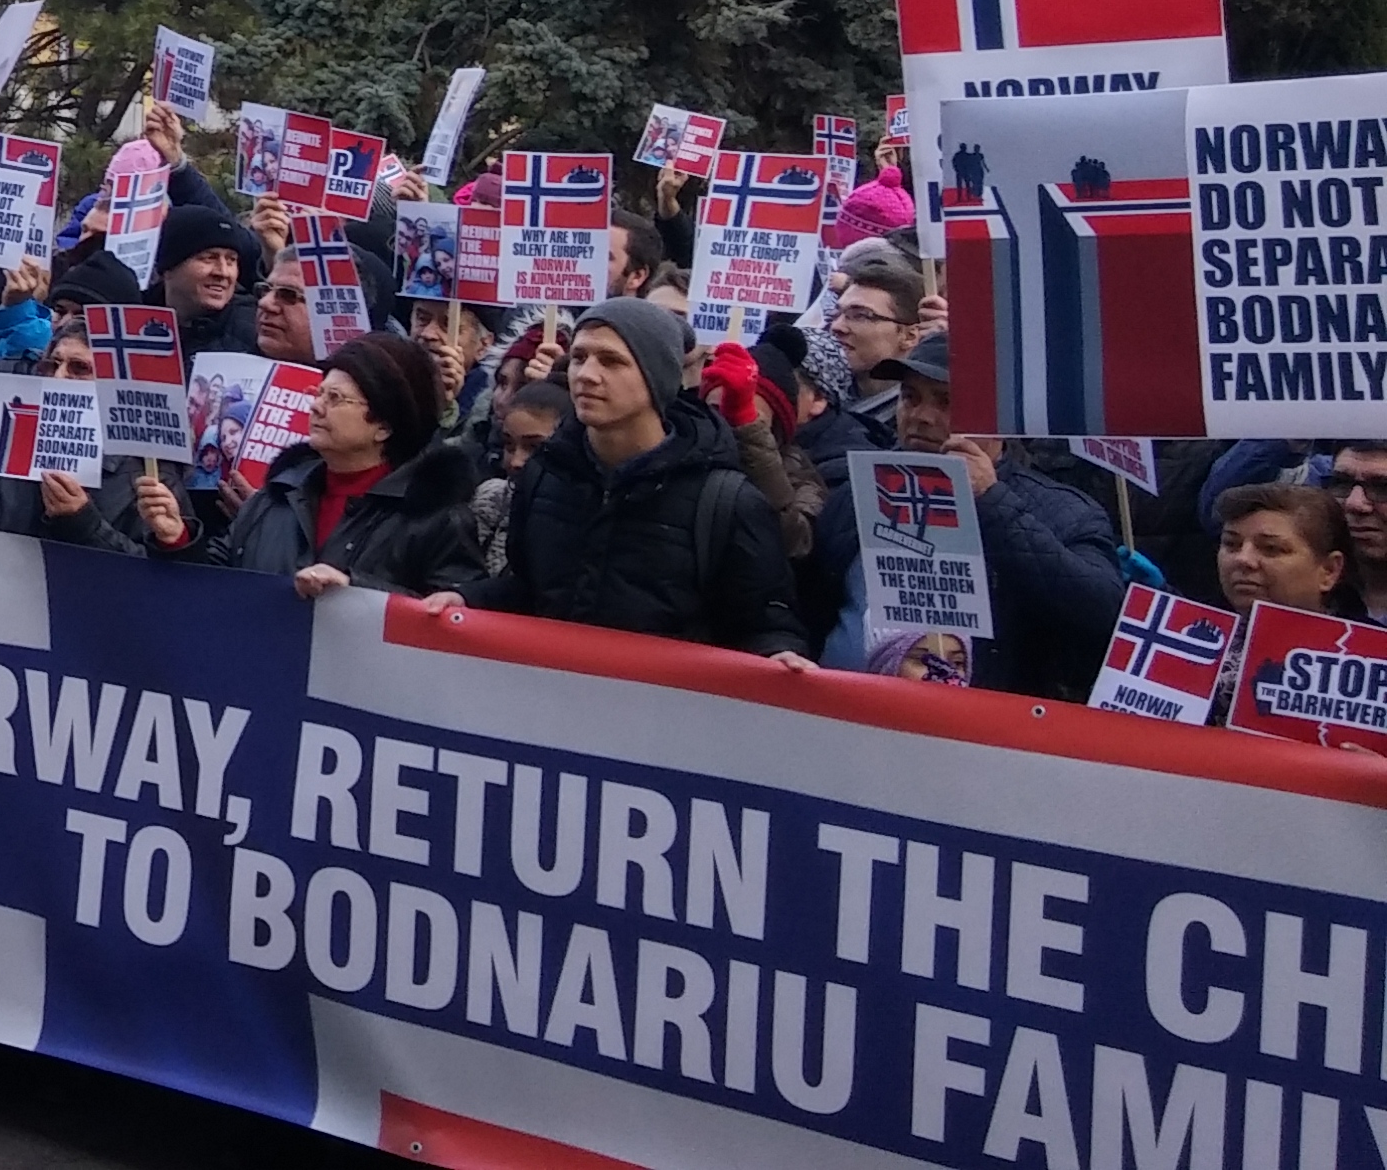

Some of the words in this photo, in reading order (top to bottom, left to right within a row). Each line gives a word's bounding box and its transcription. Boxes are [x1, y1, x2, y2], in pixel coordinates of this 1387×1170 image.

[1195, 118, 1387, 174] NORWA
[1198, 182, 1267, 231] DO
[1281, 177, 1384, 229] NOT
[522, 229, 547, 242] WHY
[549, 231, 569, 243] ARE
[572, 232, 591, 244] YOU
[723, 229, 748, 243] WHY
[750, 231, 772, 245] ARE
[776, 234, 798, 248] YOU
[512, 243, 548, 257] SILENT
[551, 245, 594, 259] EUROPE?
[710, 242, 748, 257] SILENT
[750, 246, 799, 263] EUROPE?
[533, 258, 578, 272] NORWAY
[729, 258, 779, 275] NORWAY
[517, 271, 527, 284] IS
[530, 272, 591, 287] KIDNAPPING
[710, 271, 722, 284] IS
[725, 272, 793, 292] KIDNAPPING
[514, 285, 541, 299] YOUR
[706, 285, 735, 300] YOUR
[43, 391, 94, 410] NORWAY,
[116, 389, 170, 410] NORWAY,
[41, 407, 56, 422] DO
[59, 409, 83, 424] NOT
[109, 407, 142, 424] STOP
[145, 410, 180, 429] CHILD
[39, 423, 96, 442] SEPARATE
[106, 424, 187, 448] KIDNAPPING!
[37, 439, 98, 459] BODNARIU
[34, 454, 79, 472] FAMILY!
[876, 555, 937, 576] NORWAY,
[939, 560, 972, 577] GIVE
[879, 572, 906, 588] THE
[908, 574, 975, 595] CHILDREN
[899, 590, 936, 608] BACK
[938, 593, 957, 610] TO
[883, 605, 923, 624] THEIR
[925, 610, 979, 629] FAMILY!
[1276, 693, 1387, 727] BARNEVER
[290, 721, 771, 941] RETURN
[817, 822, 1090, 1014] THE
[1145, 892, 1387, 1082] CH
[65, 808, 194, 948] TO
[228, 846, 858, 1116] BODNARIU
[910, 1001, 1387, 1170] FAMIL
